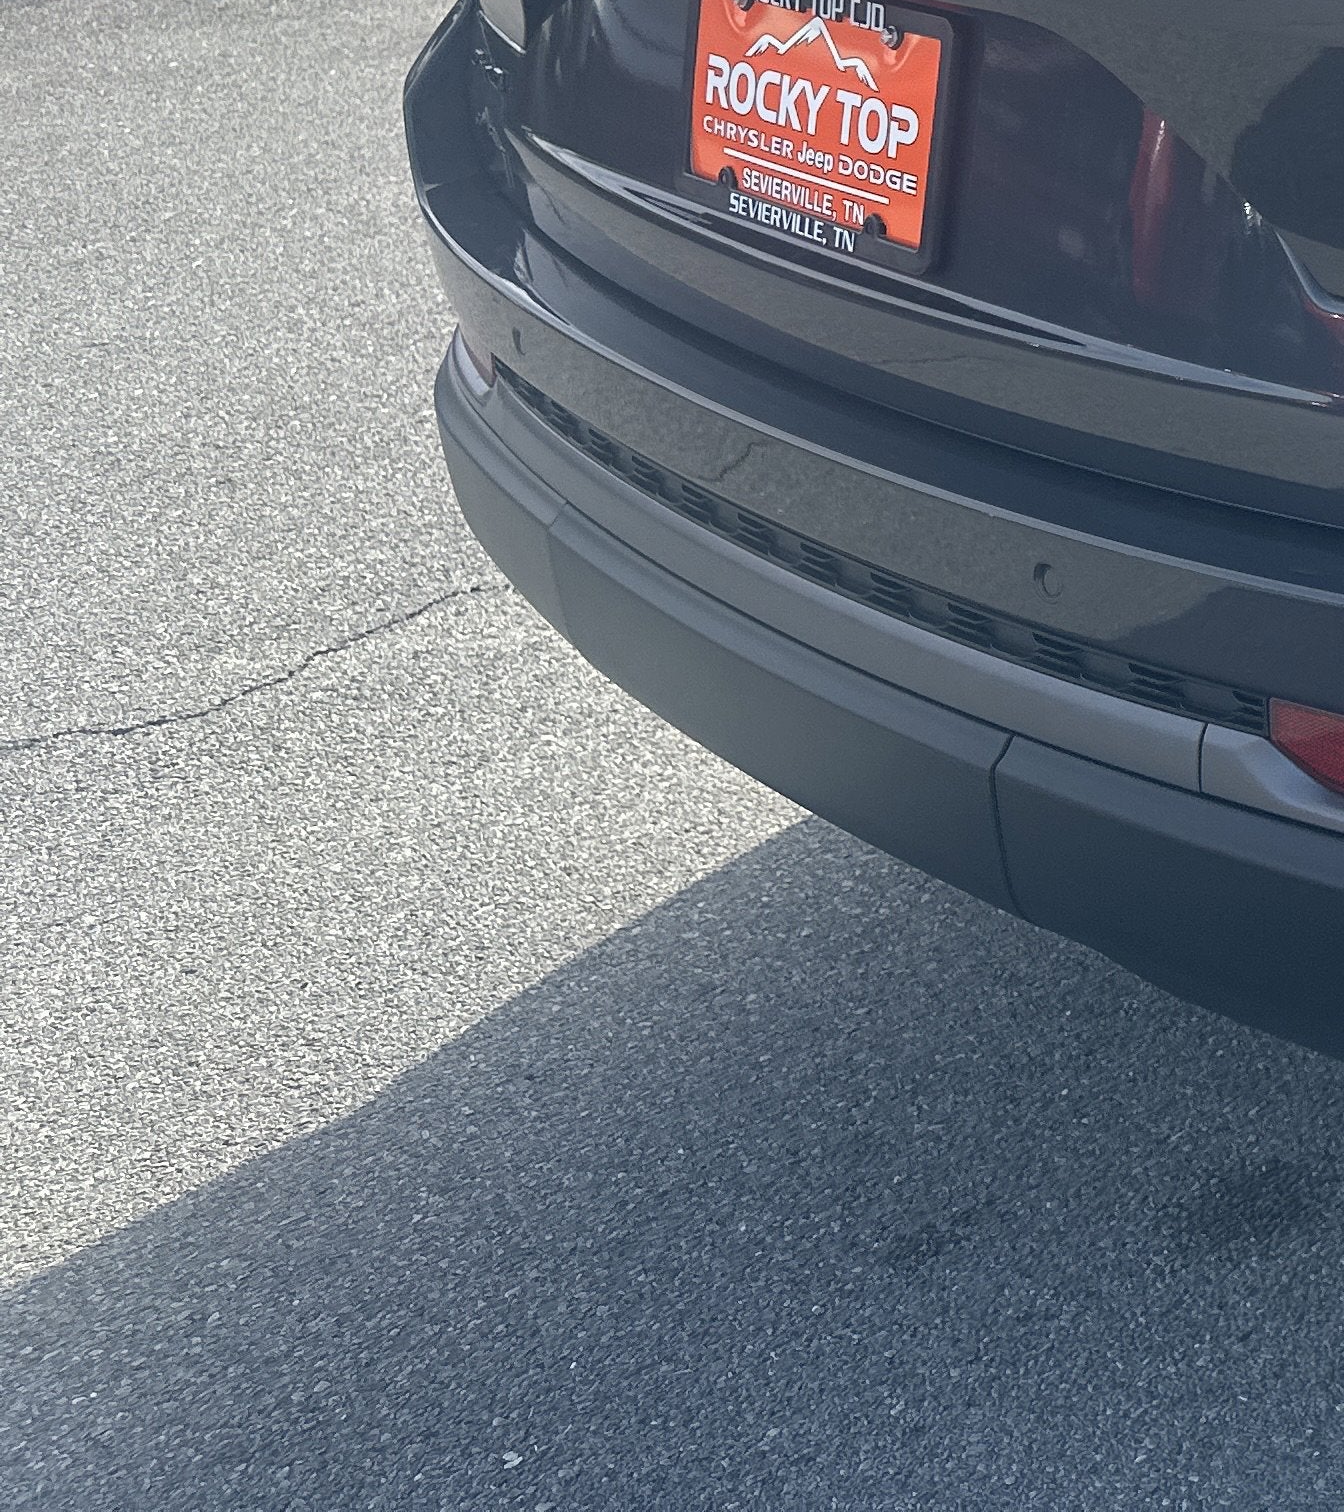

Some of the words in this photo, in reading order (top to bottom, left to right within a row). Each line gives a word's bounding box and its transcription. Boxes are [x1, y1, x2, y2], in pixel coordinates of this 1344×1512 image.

[705, 53, 831, 136] ROCKY
[836, 89, 919, 159] TOP
[702, 114, 795, 160] CHRYSLER
[796, 140, 834, 174] Jeep
[838, 154, 919, 197] DODGE
[728, 191, 828, 247] SEVIERVILLE,
[832, 225, 856, 253] TN
[741, 166, 838, 222] SEVIERVILLE,
[842, 199, 866, 227] TN
